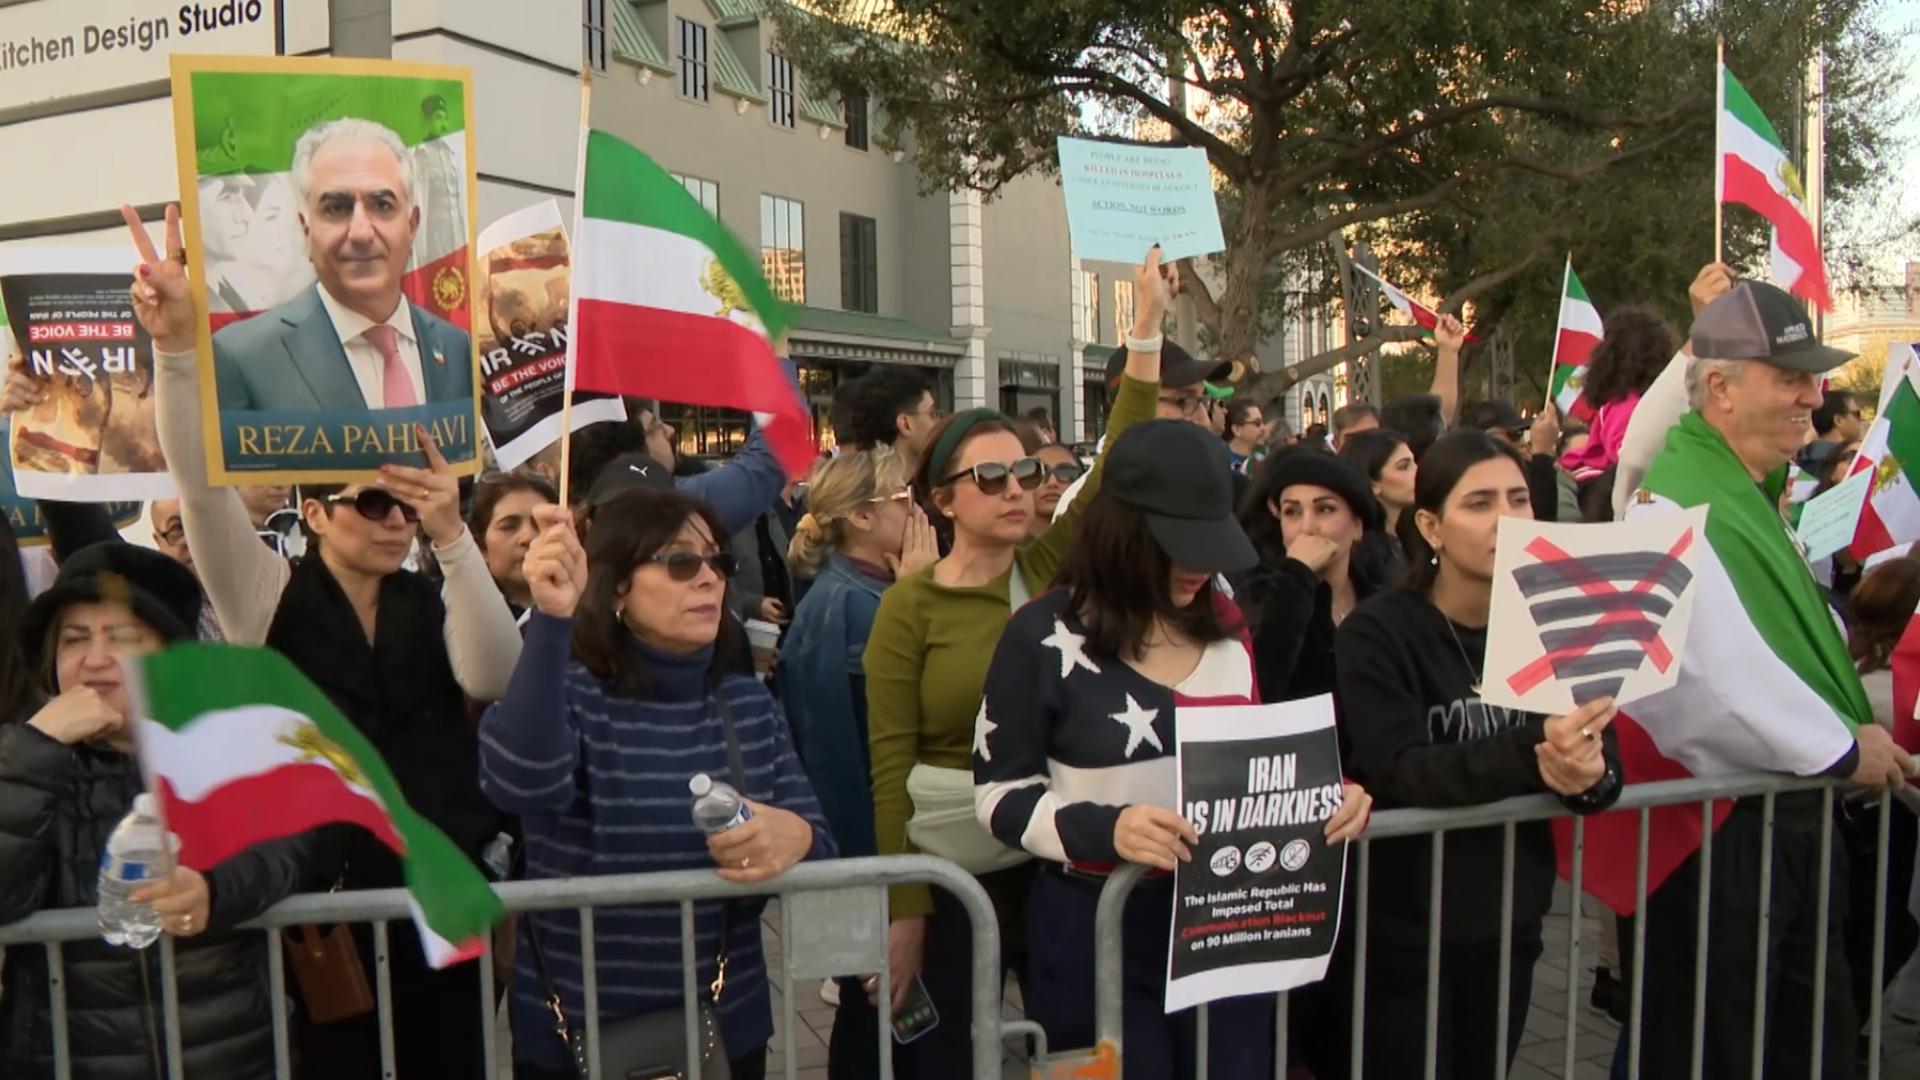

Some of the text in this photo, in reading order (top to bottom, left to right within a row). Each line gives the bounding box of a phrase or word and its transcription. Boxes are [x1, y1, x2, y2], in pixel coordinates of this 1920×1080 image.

[84, 17, 169, 53] Design
[178, 0, 262, 36] Studio
[1131, 169, 1183, 179] HOSPITALS
[1150, 205, 1186, 216] WORDS
[30, 324, 134, 340] BE THE VOICE
[491, 354, 567, 393] BE THE VOIC
[236, 413, 468, 456] REZA PAHLAVI
[1248, 753, 1297, 794] IRAN
[1185, 782, 1344, 836] IS IN DARKNESS
[1184, 881, 1327, 908] The Islamic Republic Has
[1212, 897, 1295, 919] Imposed Total
[1182, 910, 1327, 939] Communication Blackout
[1190, 926, 1312, 951] on 90 Million Iranians
